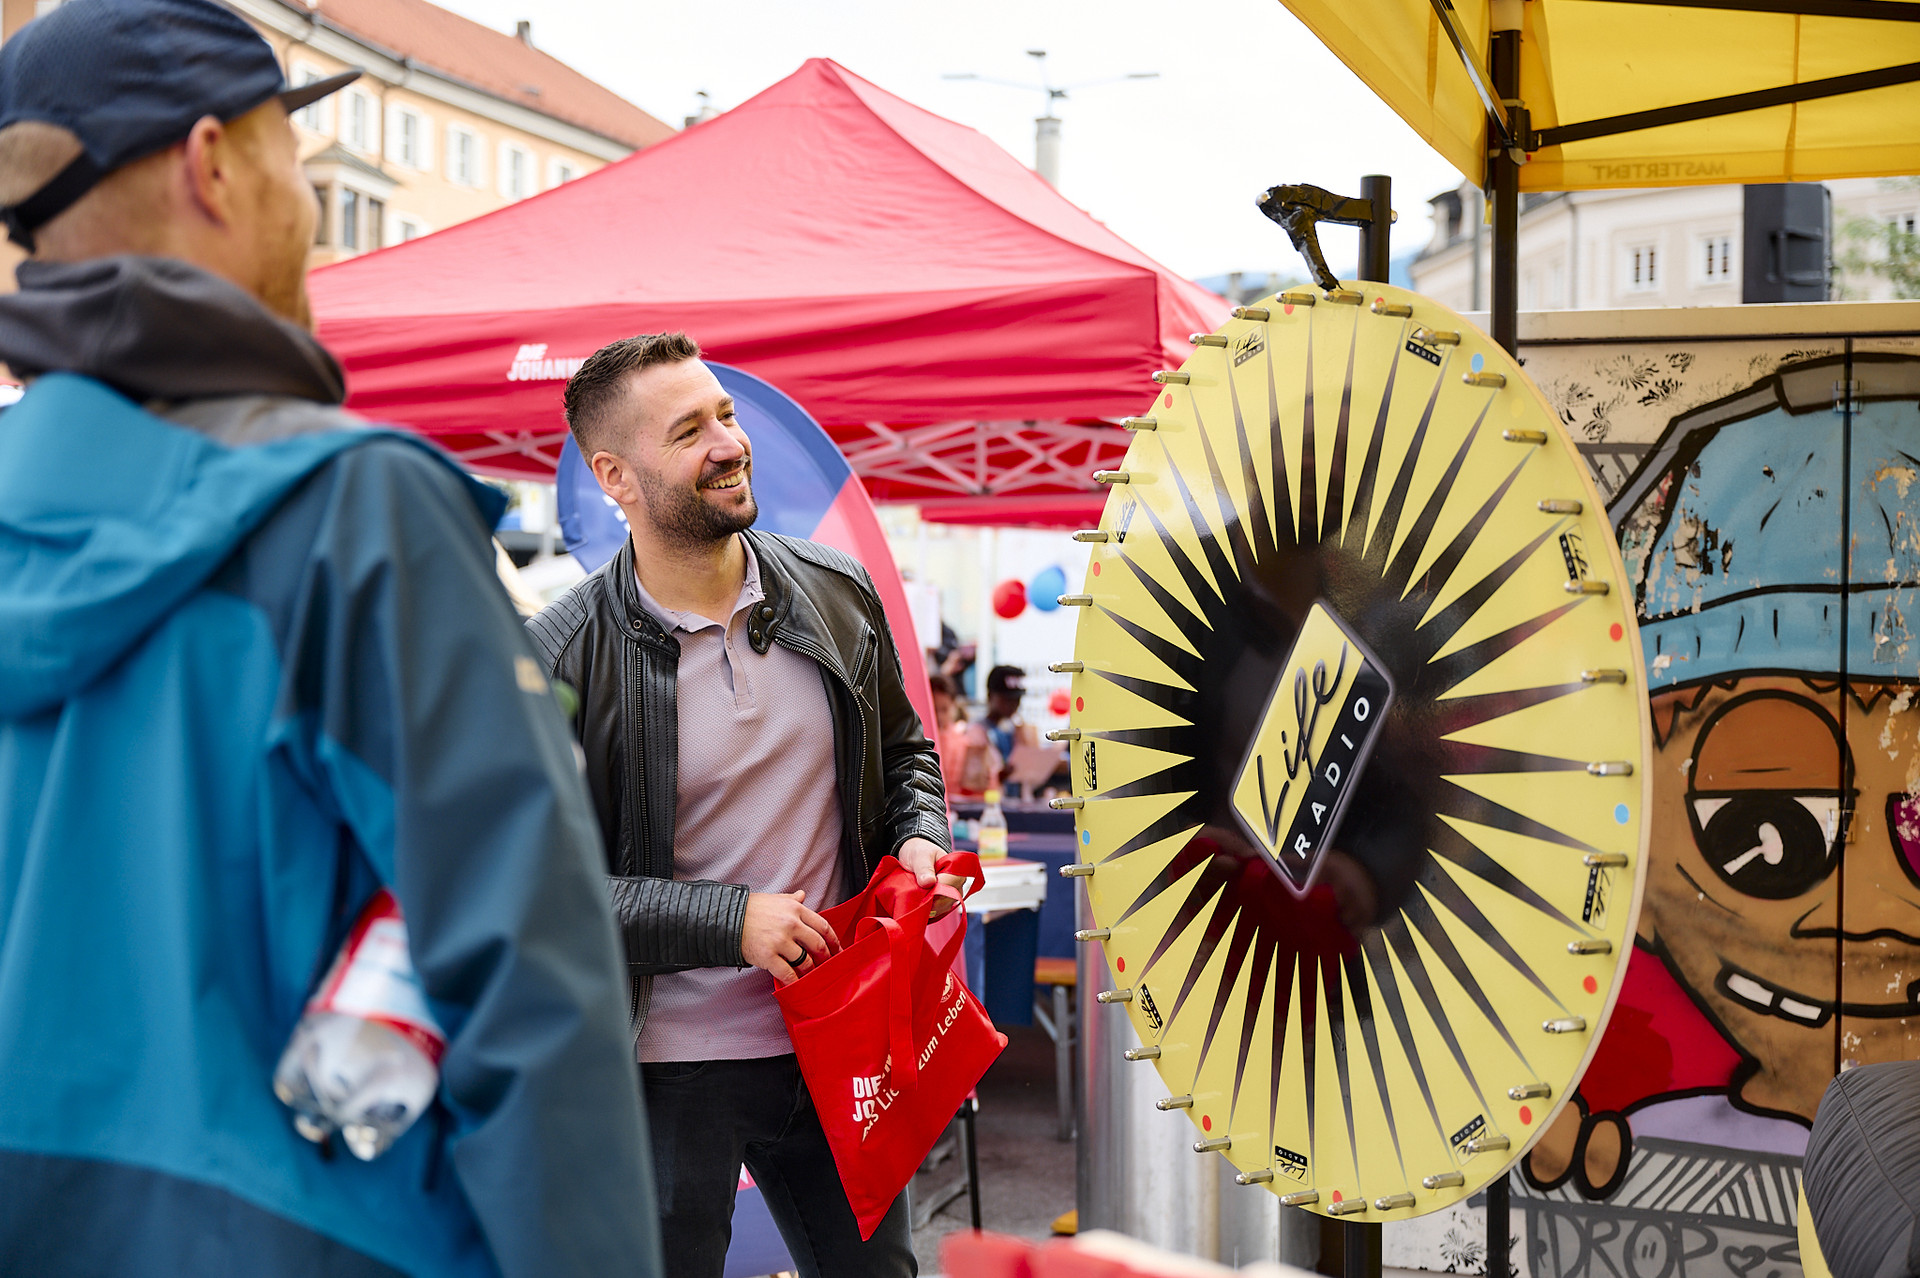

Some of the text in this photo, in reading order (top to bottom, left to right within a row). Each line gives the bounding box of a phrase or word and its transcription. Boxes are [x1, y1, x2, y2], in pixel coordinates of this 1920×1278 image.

[515, 343, 548, 361] DIE
[1408, 343, 1438, 363] RADIO
[1256, 640, 1349, 847] Life
[1294, 696, 1371, 859] RADIO
[937, 990, 967, 1036] Leben
[852, 1074, 882, 1098] DIE
[1453, 1119, 1482, 1143] RADIO
[1278, 1149, 1304, 1164] RADIO
[1276, 1158, 1306, 1180] Life
